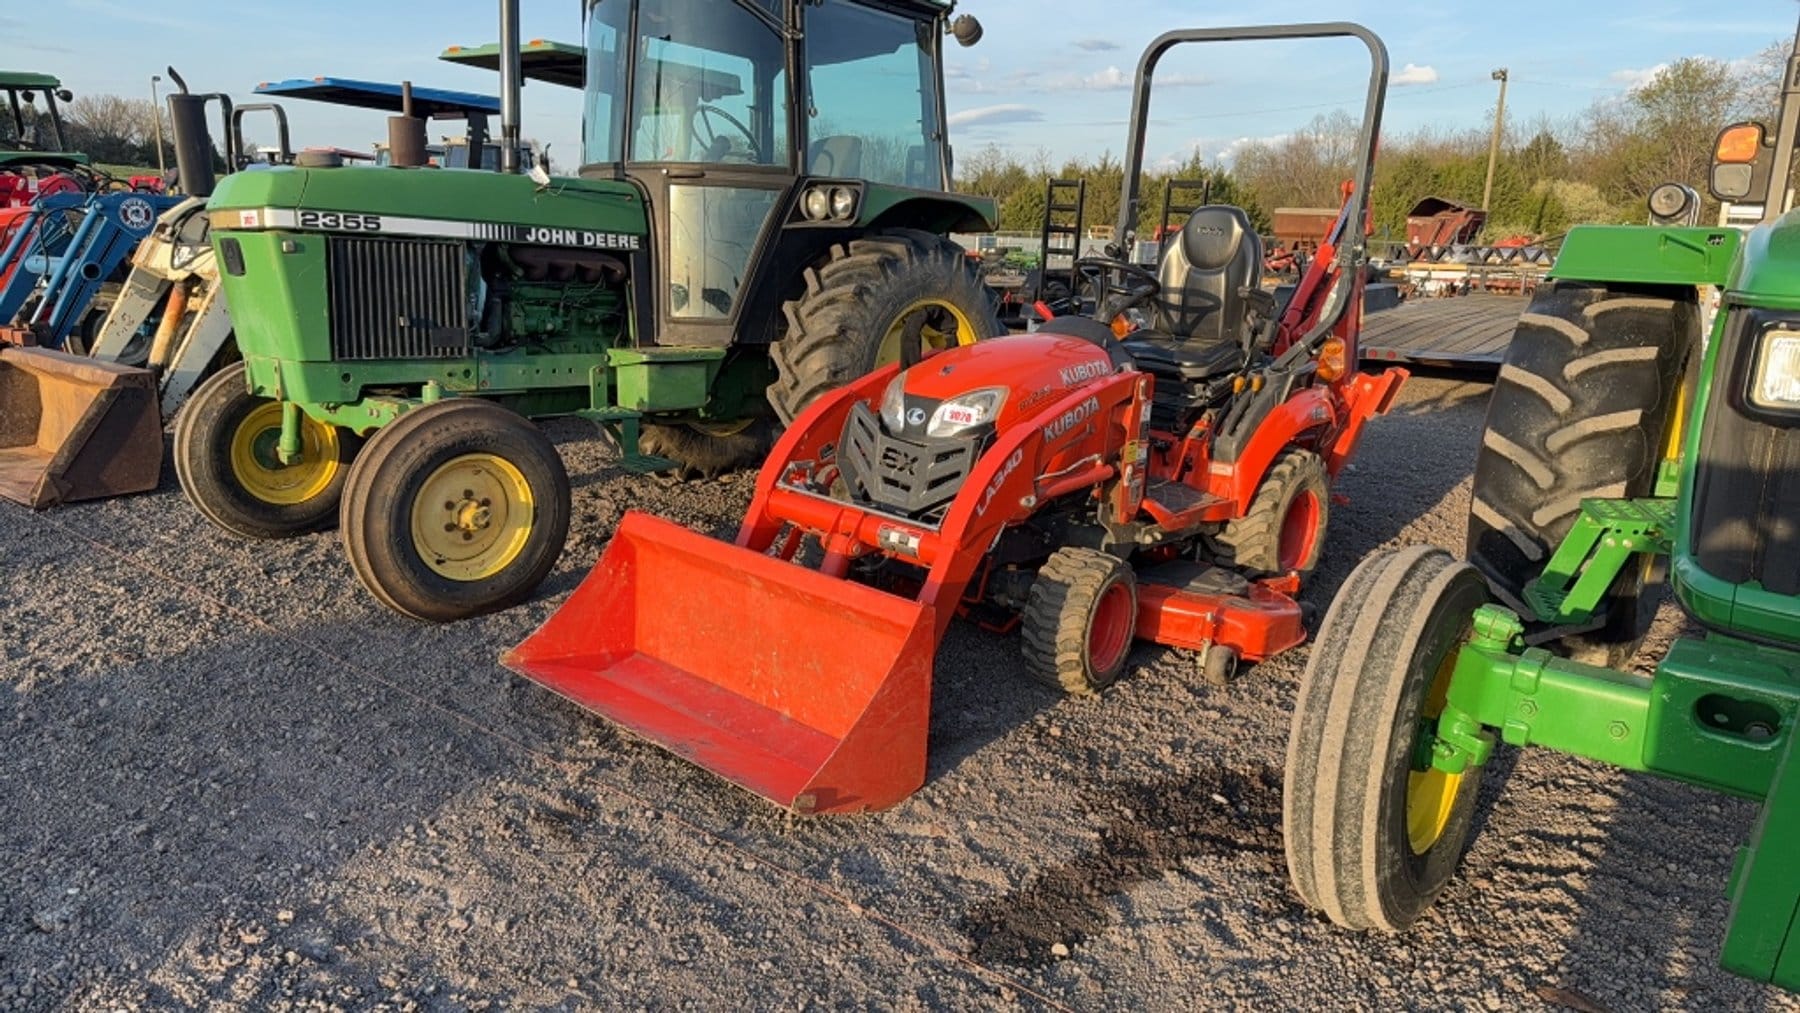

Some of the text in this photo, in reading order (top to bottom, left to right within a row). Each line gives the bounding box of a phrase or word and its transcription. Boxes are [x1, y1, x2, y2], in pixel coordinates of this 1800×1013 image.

[300, 211, 382, 231] 2355
[526, 227, 640, 250] JOHN DEERE
[1059, 360, 1109, 386] KUBOTA
[1044, 396, 1100, 442] KUBOTA
[975, 447, 1024, 516] LA340
